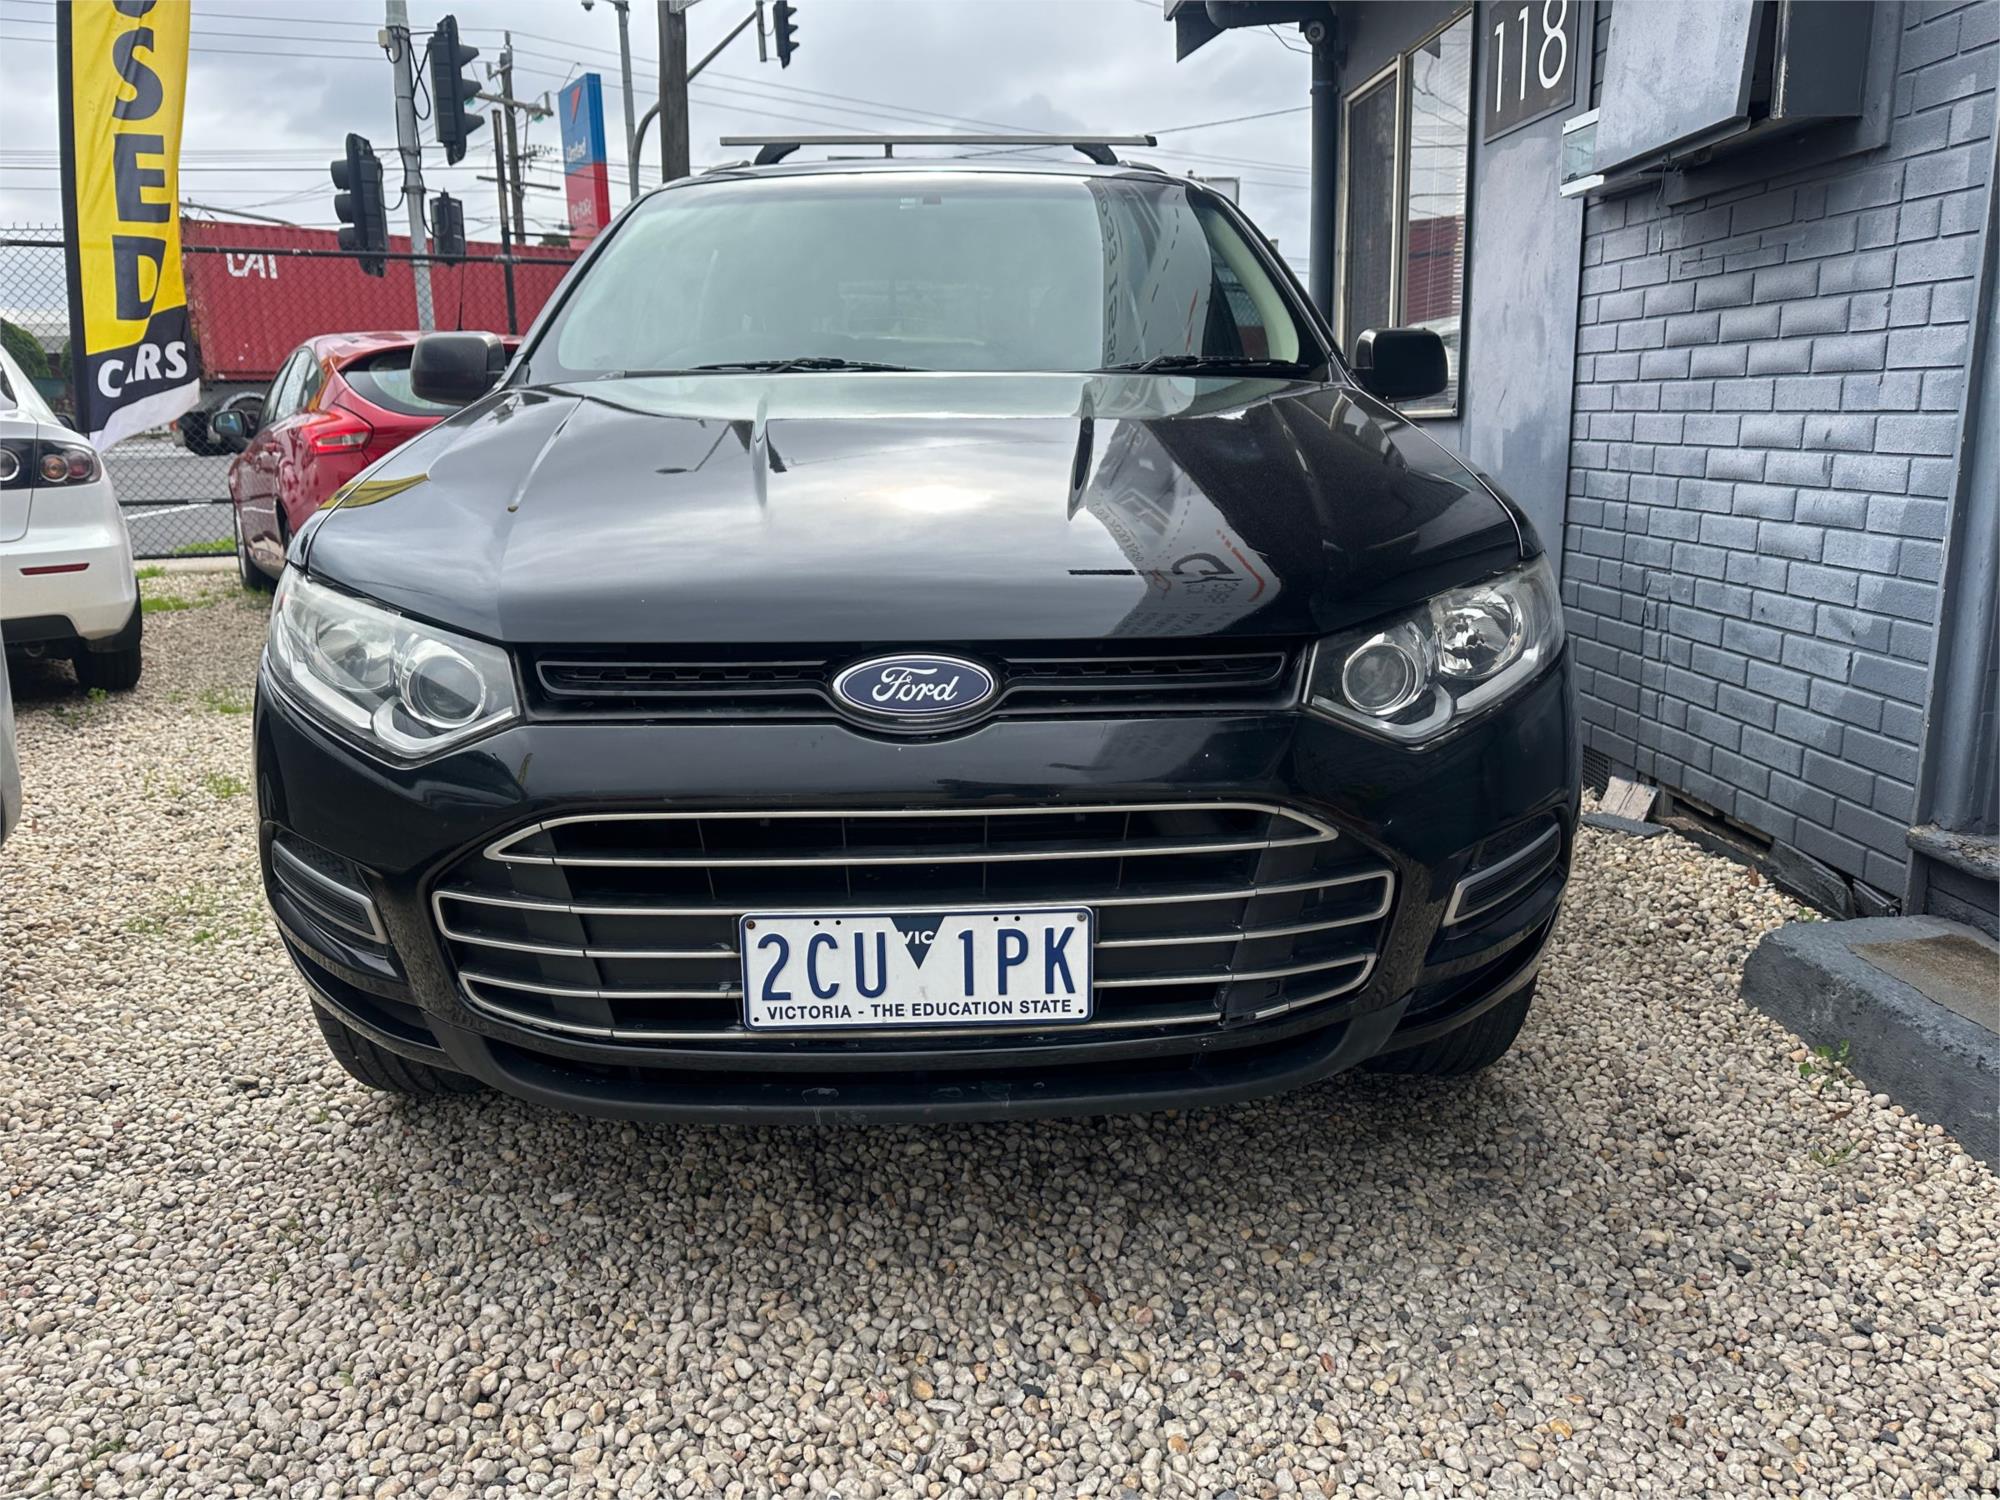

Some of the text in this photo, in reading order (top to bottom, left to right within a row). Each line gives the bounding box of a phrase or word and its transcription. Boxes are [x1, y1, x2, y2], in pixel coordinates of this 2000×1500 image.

[1494, 0, 1568, 113] 118
[112, 0, 171, 320] SED
[872, 666, 960, 702] Ford
[757, 926, 1076, 1001] 2CU 1PK
[900, 929, 935, 945] VIC
[766, 1003, 852, 1021] VICTORIA
[870, 1003, 905, 1018] THE
[911, 1001, 1014, 1017] EDUCATION
[1018, 999, 1073, 1015] STATE
